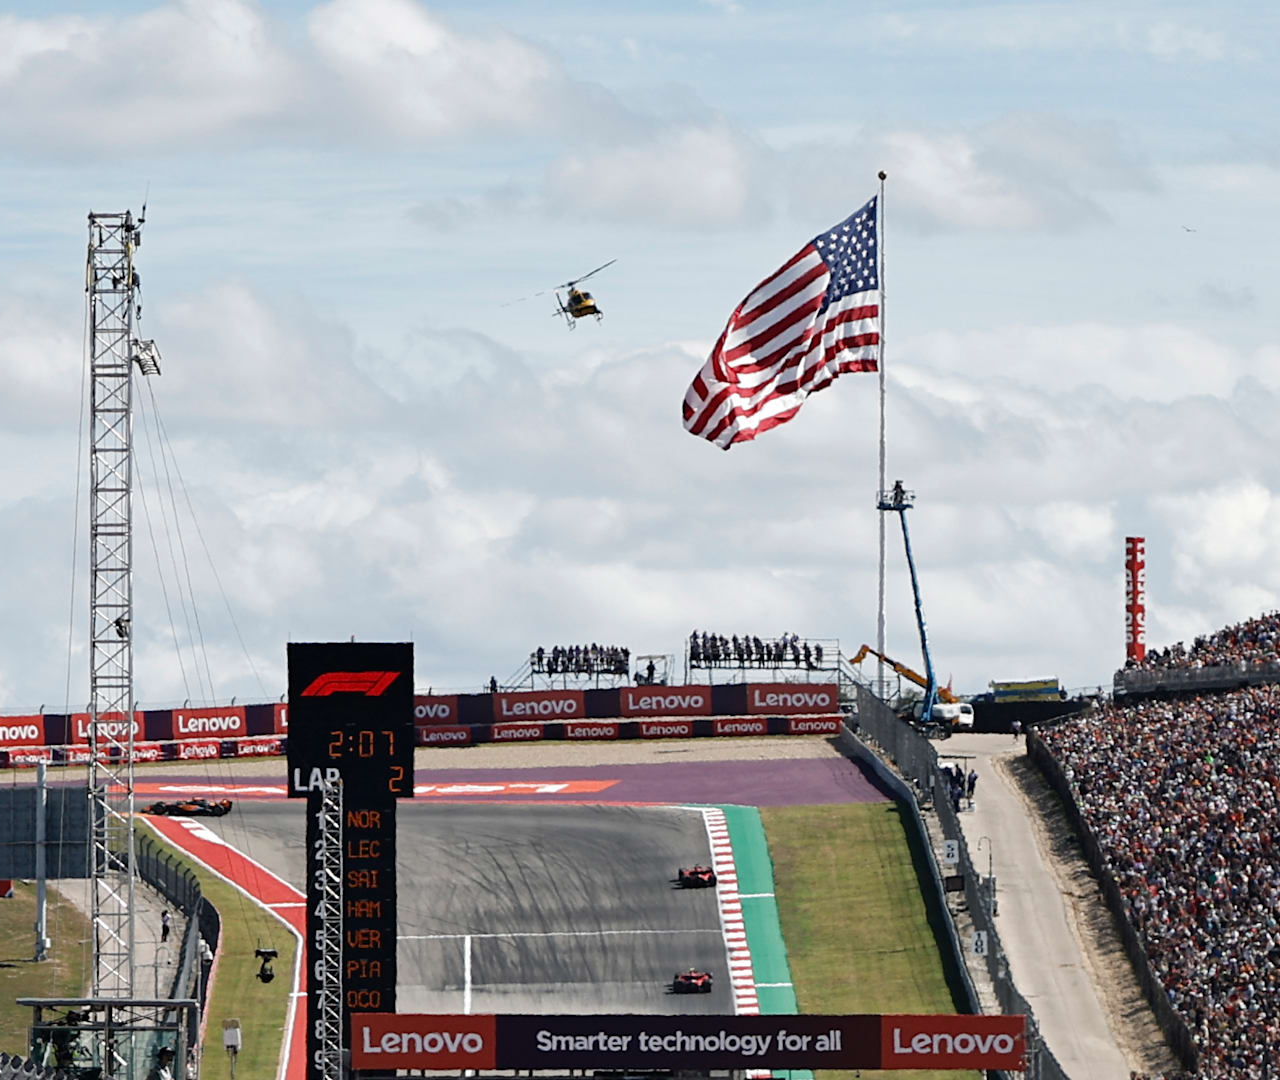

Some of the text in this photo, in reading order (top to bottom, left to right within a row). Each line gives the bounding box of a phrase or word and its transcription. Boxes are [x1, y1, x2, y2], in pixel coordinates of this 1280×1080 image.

[501, 697, 577, 716] Lenovo
[628, 692, 704, 711] Lenovo
[754, 688, 830, 708] Lenovo
[415, 704, 450, 719] ovo
[178, 714, 241, 733] Lenovo
[567, 724, 614, 738] Lenovo
[641, 722, 689, 736] Lenovo
[716, 721, 763, 733] Lenovo
[791, 719, 837, 732] Lenovo
[422, 730, 468, 743] Lenovo
[493, 727, 540, 740] Lenovo
[180, 743, 217, 759] Lenovo
[238, 741, 276, 755] Lenovo
[328, 730, 395, 758] 2:07
[293, 767, 341, 793] LAP
[389, 766, 404, 793] 2
[347, 810, 382, 830] NOR
[347, 840, 381, 859] LEC
[347, 870, 380, 889] SAI
[347, 900, 382, 919] HAM
[347, 930, 382, 949] VER
[347, 960, 382, 979] PIA
[362, 1027, 483, 1054] Lenovo
[536, 1029, 841, 1056] Smarter technology for all
[893, 1027, 1015, 1054] Lenovo
